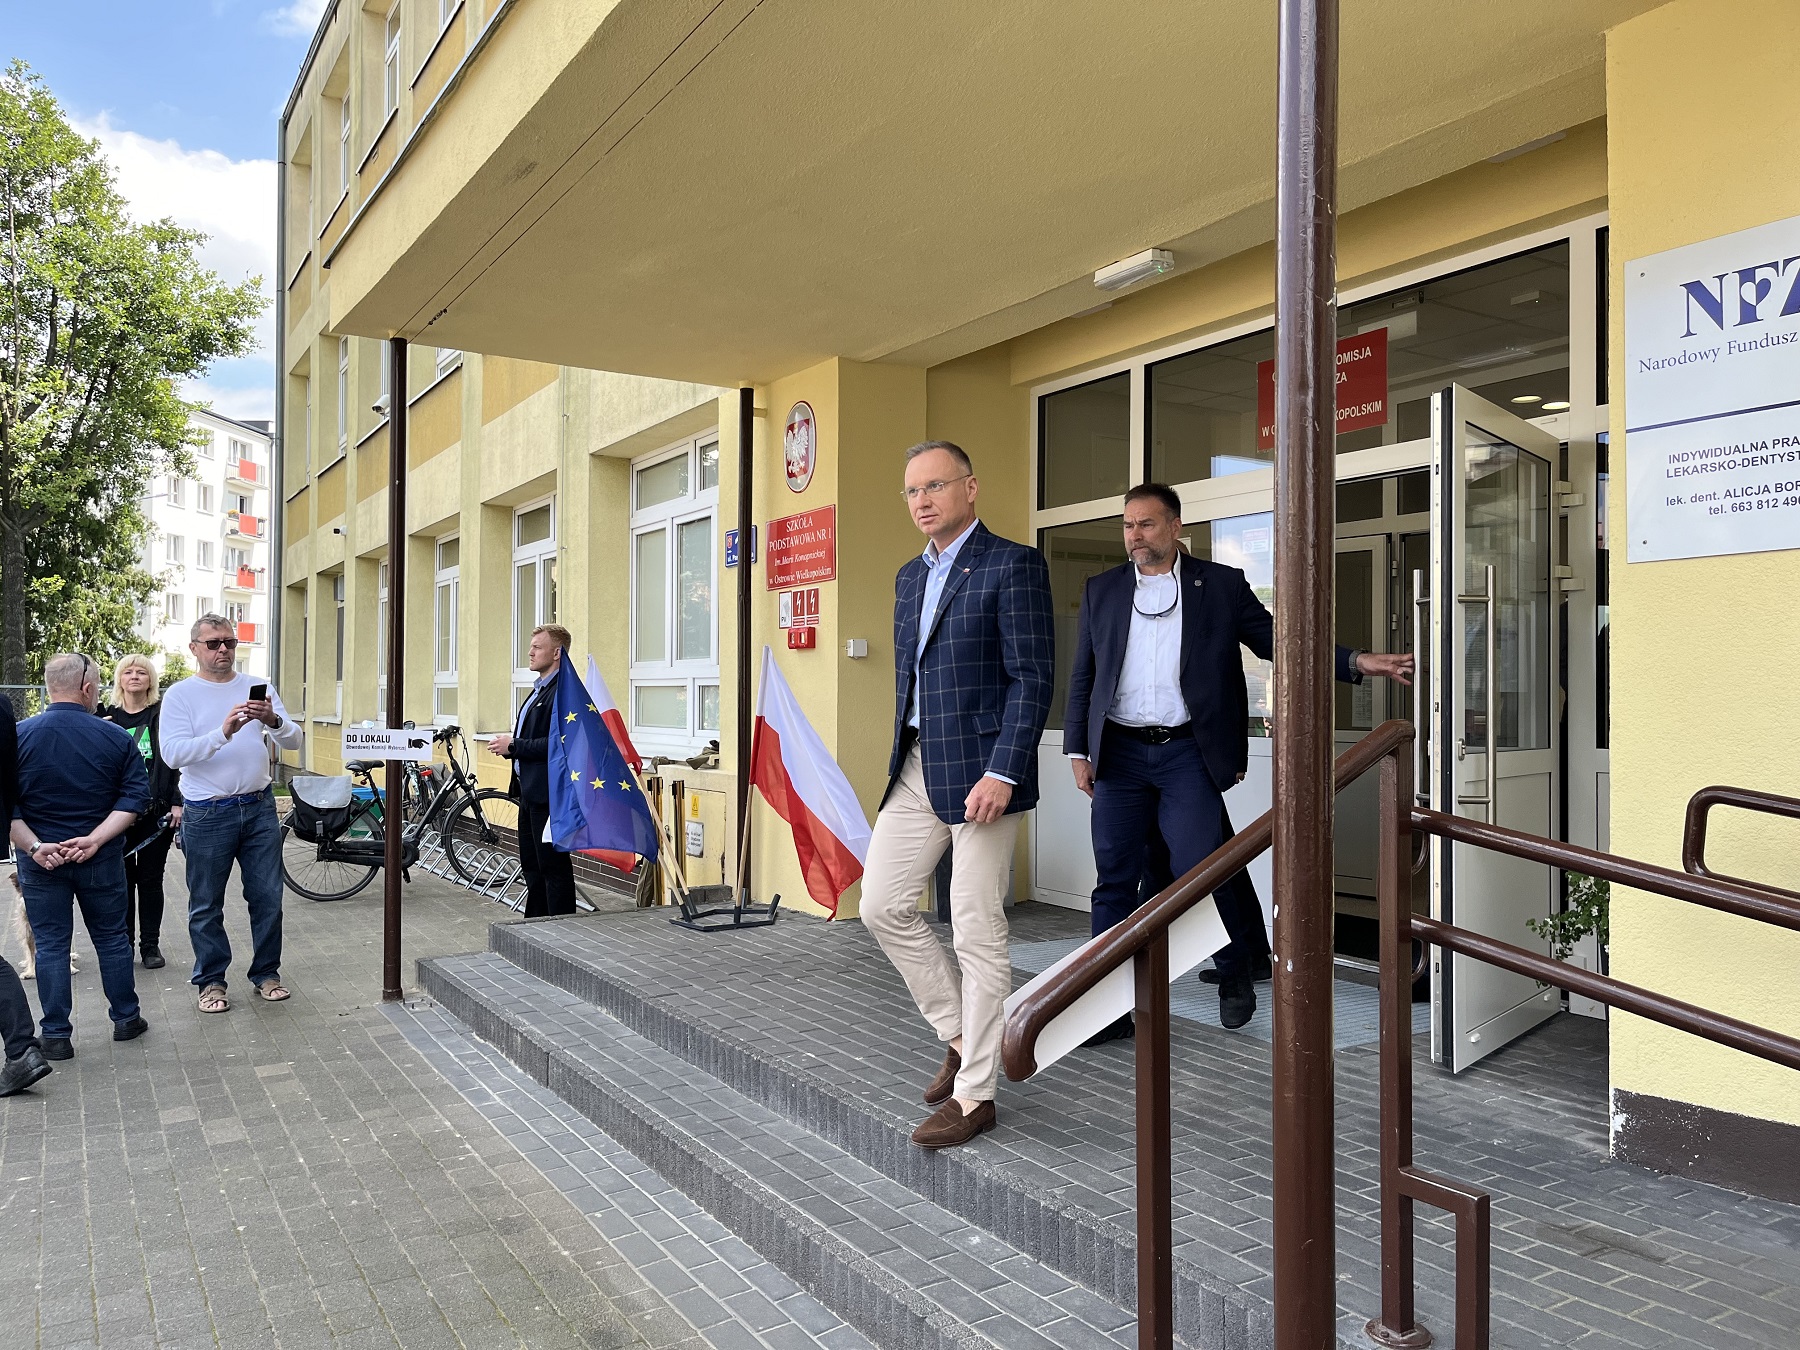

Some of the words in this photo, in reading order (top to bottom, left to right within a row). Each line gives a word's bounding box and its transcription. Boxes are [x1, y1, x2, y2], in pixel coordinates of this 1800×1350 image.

[1336, 346, 1372, 365] OMISJA
[1639, 347, 1720, 373] Narodowy
[1727, 332, 1799, 355] Fundusz
[1261, 425, 1269, 437] W
[1668, 440, 1768, 464] INDYWIDUALNA
[1772, 436, 1800, 450] PRA
[1666, 497, 1687, 507] lek.
[1690, 491, 1720, 503] dent.
[1723, 484, 1771, 499] ALICJA
[1708, 504, 1727, 515] tel.
[1731, 501, 1753, 512] 663
[1756, 498, 1779, 510] 812
[786, 516, 813, 532] SZKOŁA
[769, 532, 816, 552] PODSTAWOWA
[816, 529, 827, 541] NR
[774, 572, 795, 584] Ostrowie
[795, 566, 832, 580] Wielkopolskim
[346, 734, 357, 743] DO
[361, 734, 391, 743] LOKALU
